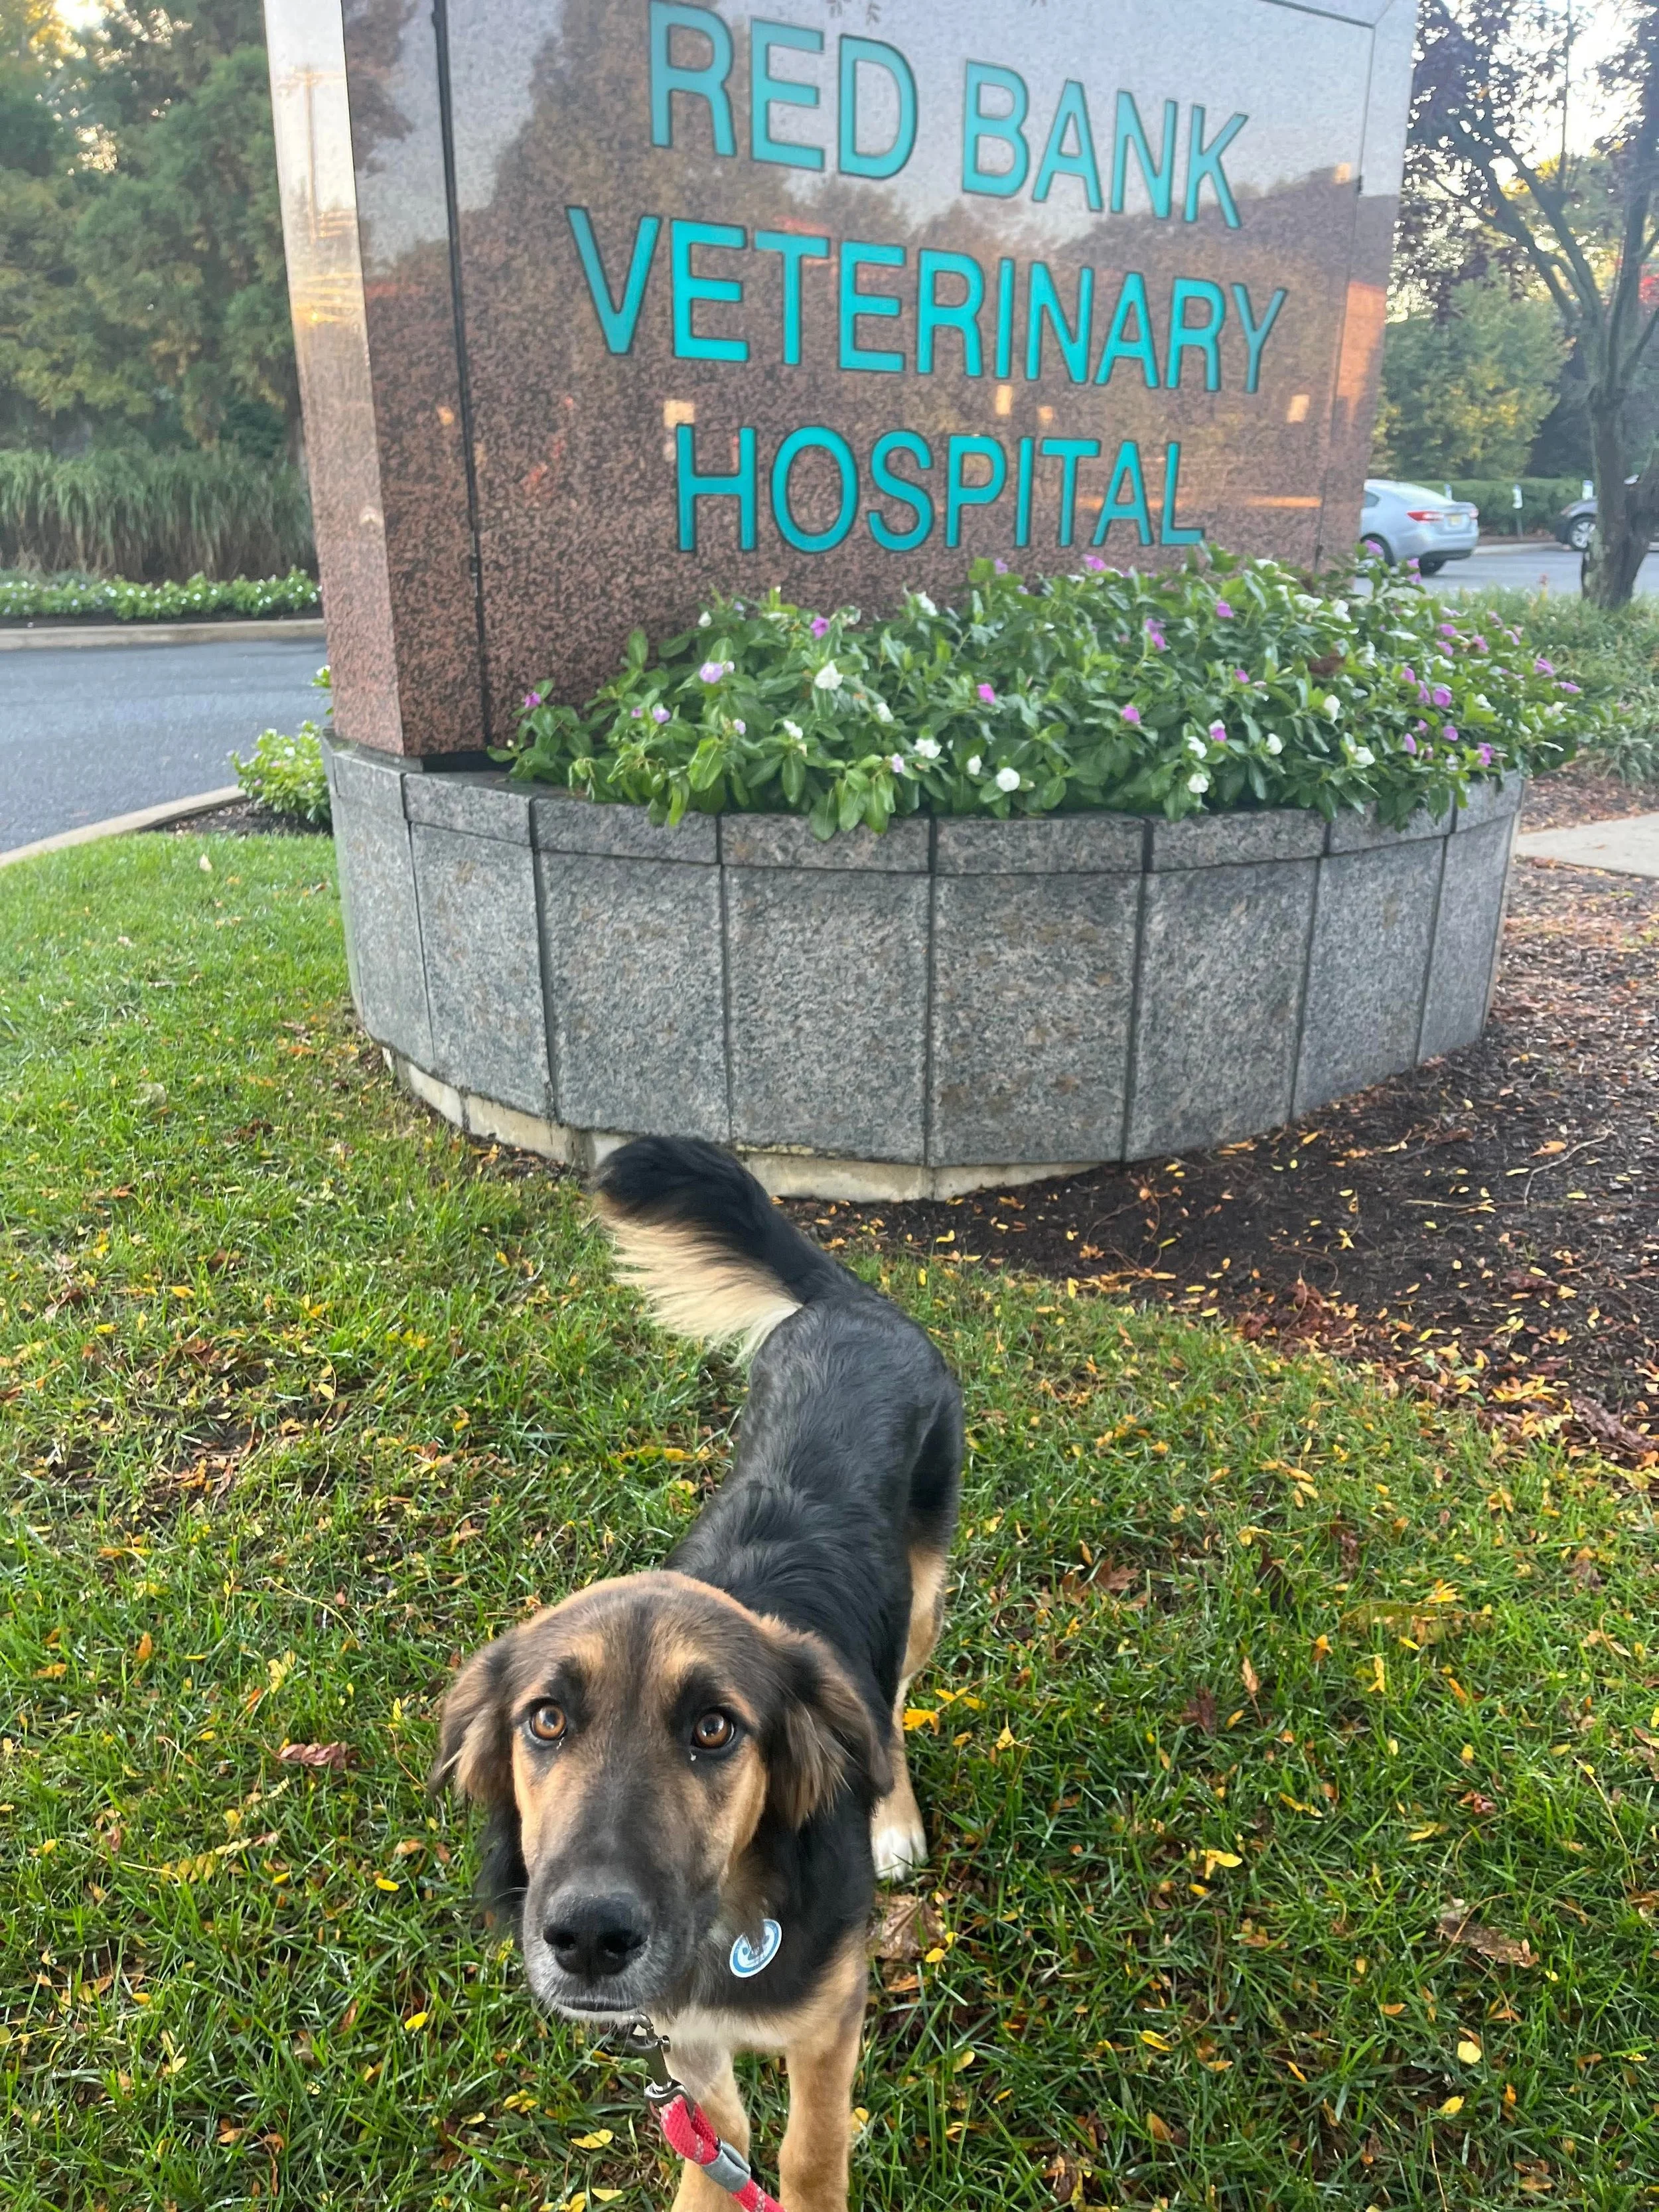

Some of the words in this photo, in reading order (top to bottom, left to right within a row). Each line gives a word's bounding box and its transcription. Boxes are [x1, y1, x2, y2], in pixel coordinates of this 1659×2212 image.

[649, 1, 918, 179] RED
[962, 58, 1248, 229] BANK
[566, 206, 1286, 393] VETERINARY
[676, 424, 1206, 553] HOSPITAL
